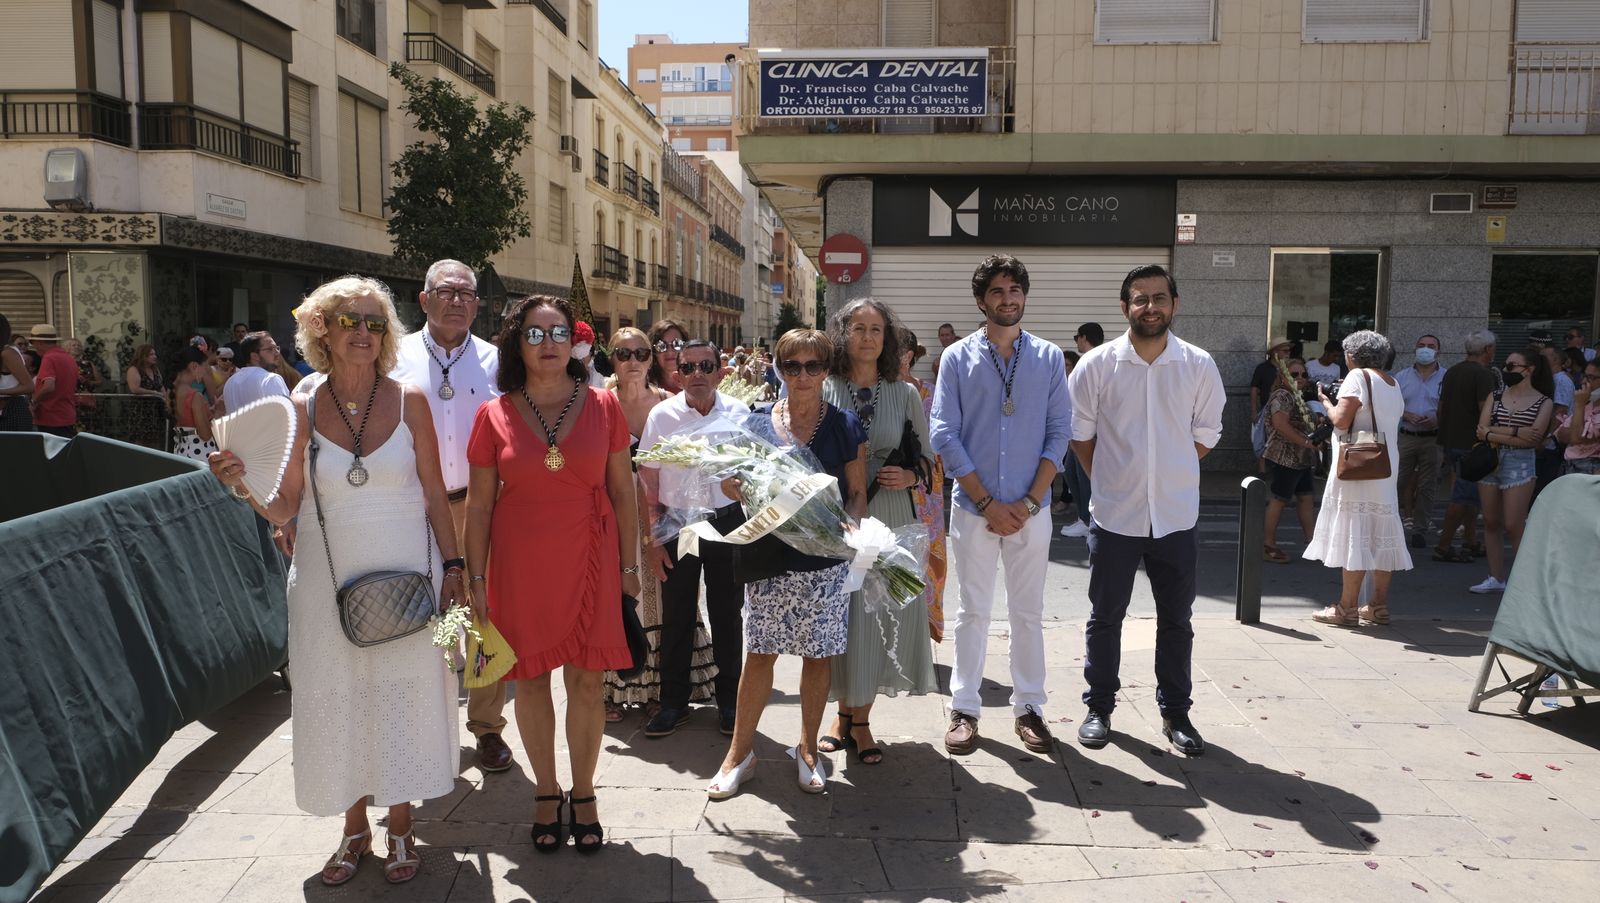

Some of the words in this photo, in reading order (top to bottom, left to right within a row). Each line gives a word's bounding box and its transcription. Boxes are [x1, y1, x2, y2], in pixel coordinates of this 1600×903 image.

[768, 62, 869, 79] CLINICA
[879, 61, 980, 77] DENTAL
[779, 84, 800, 93] Dr.
[806, 84, 866, 93] Francisco
[874, 84, 906, 93] Caba
[911, 83, 969, 93] Calvache
[779, 96, 799, 105] Dr.
[804, 96, 866, 107] Alejandro
[874, 95, 906, 105] Caba
[911, 95, 969, 105] Calvache
[766, 107, 845, 115] ORTODONCIA
[861, 106, 891, 114] 950-27
[893, 106, 905, 114] 19
[907, 106, 918, 114] 53
[925, 106, 956, 114] 950-23
[958, 106, 969, 114] 76
[971, 106, 983, 114] 97
[993, 193, 1056, 211] MAÑAS
[1065, 196, 1119, 211] CANO
[993, 213, 1119, 223] INMOBILIARIA
[737, 506, 781, 541] SANTO
